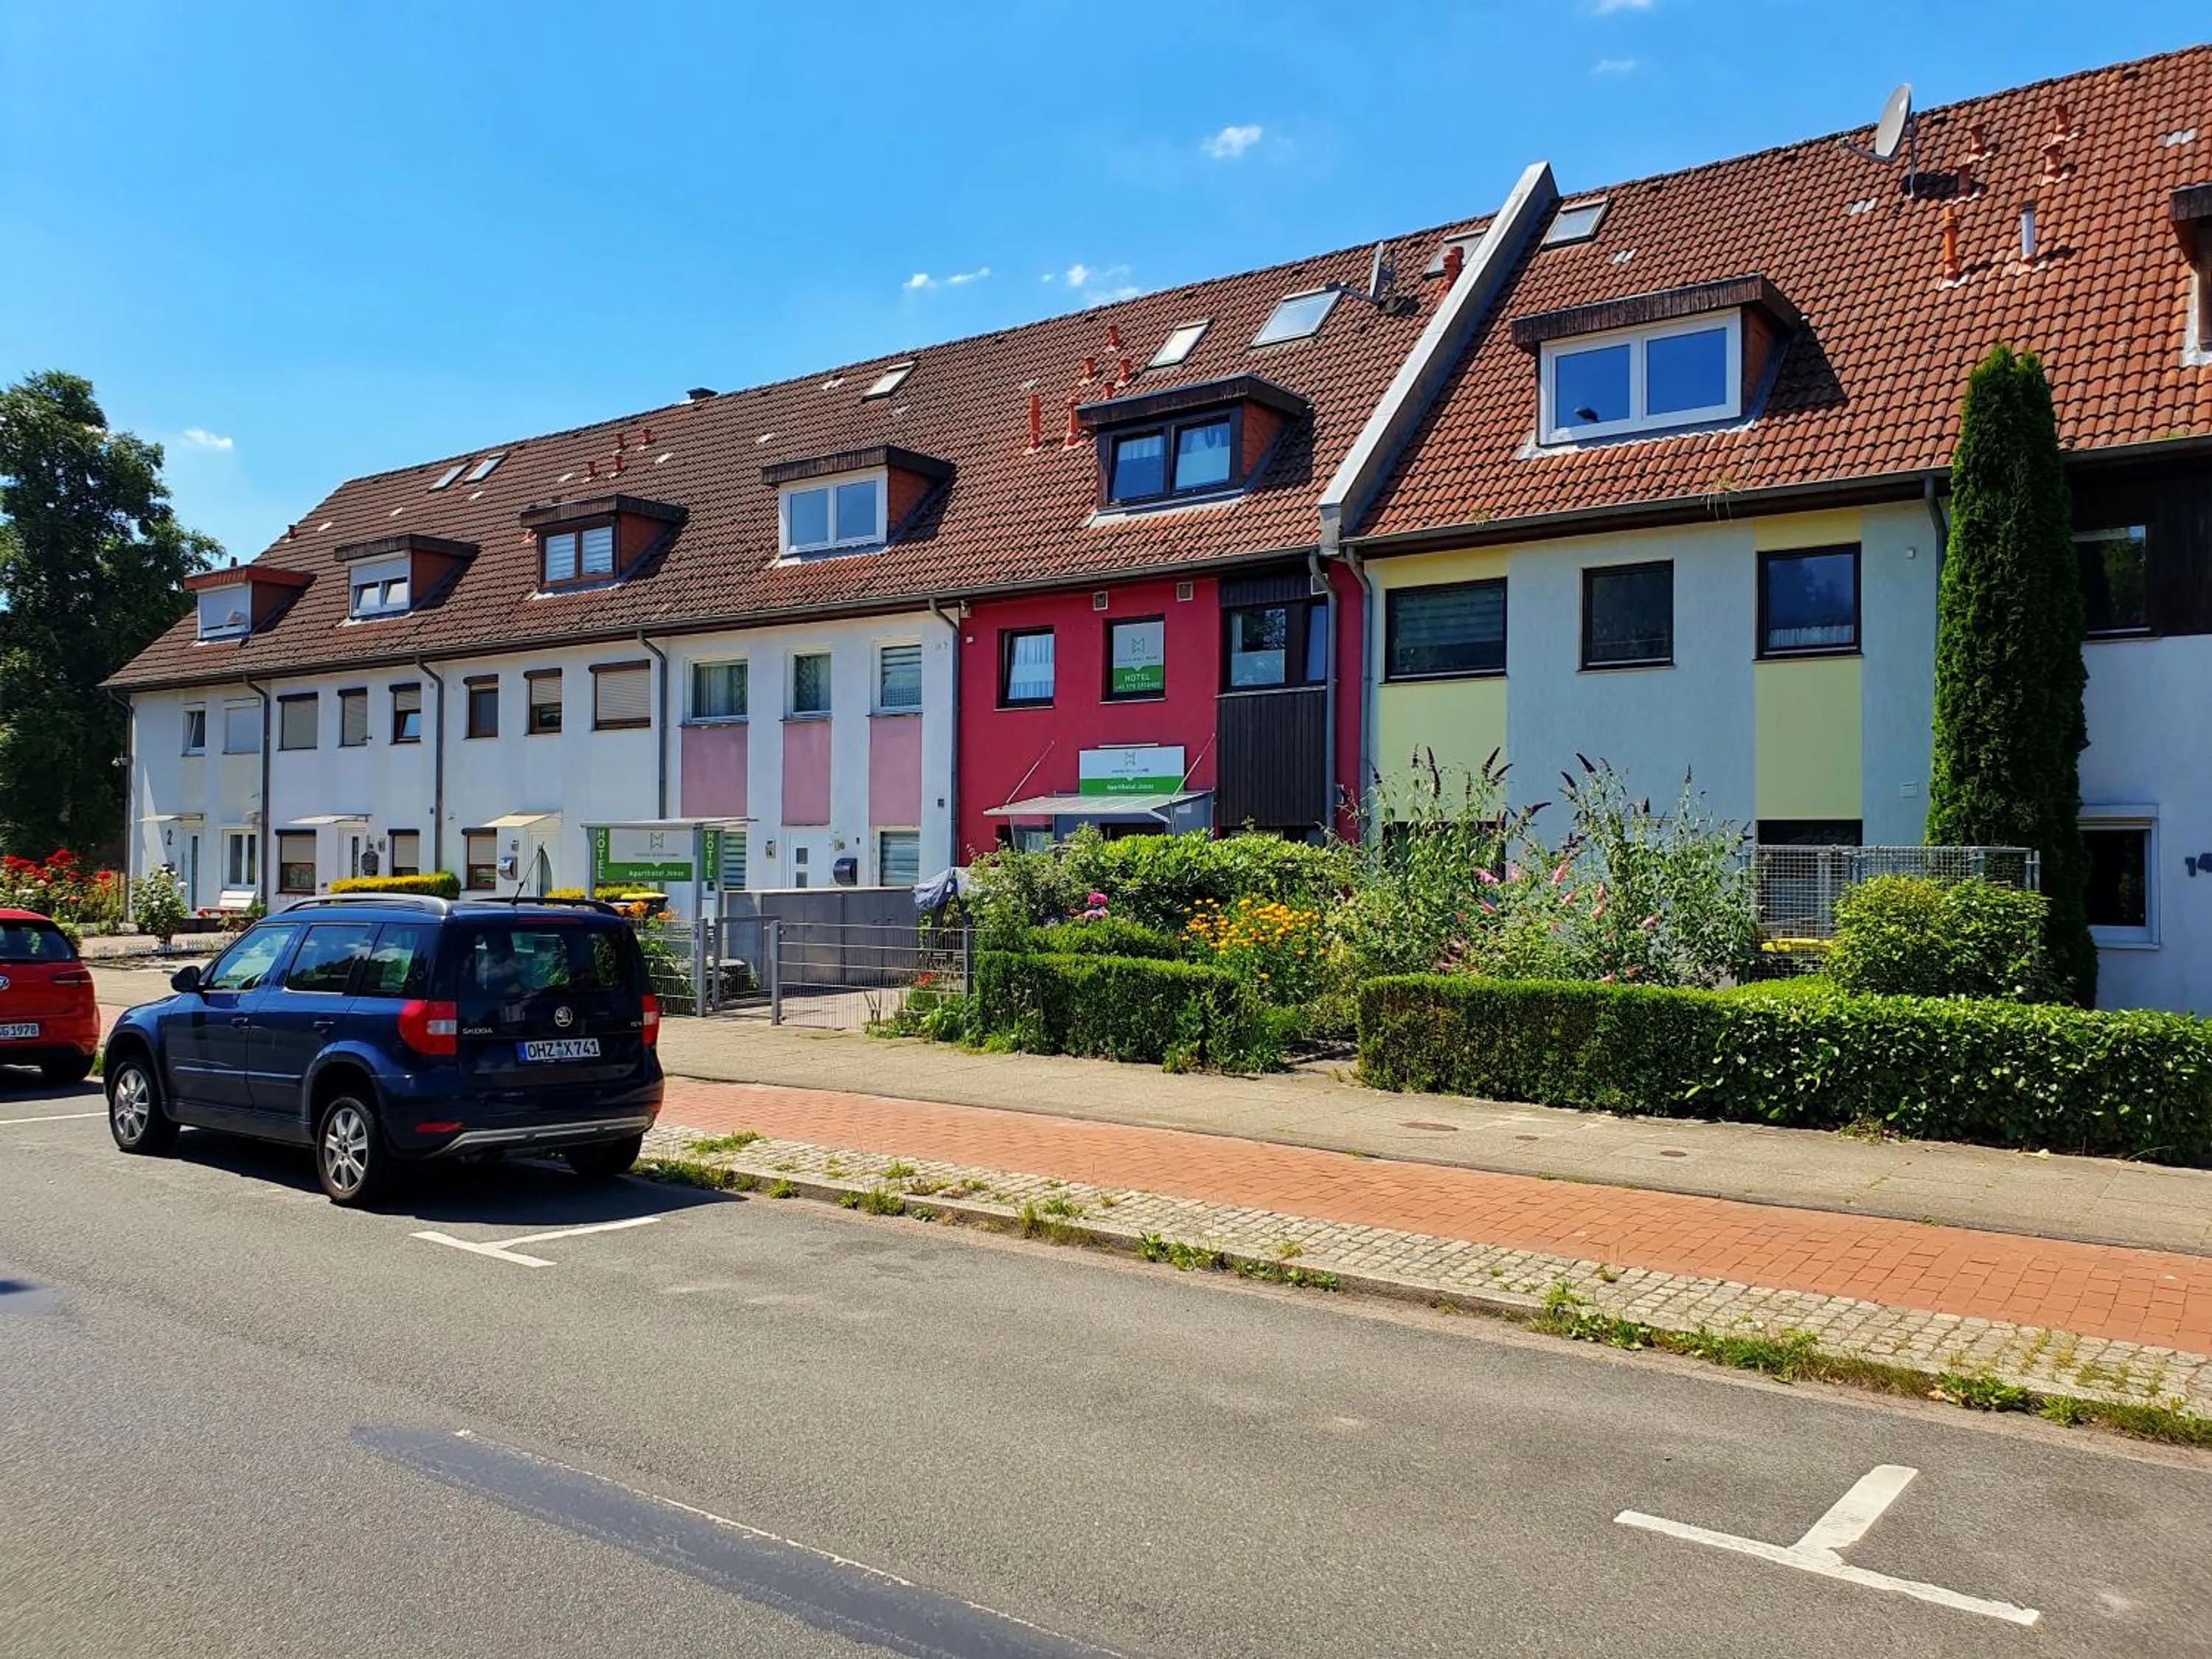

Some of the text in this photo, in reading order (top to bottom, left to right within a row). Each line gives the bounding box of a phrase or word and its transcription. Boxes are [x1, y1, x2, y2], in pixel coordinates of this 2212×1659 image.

[1124, 673, 1150, 683] HOTEL
[597, 828, 605, 879] HOTEL
[706, 832, 714, 878] HOTEL
[628, 870, 664, 878] Aparthotel
[527, 1042, 555, 1058] OHZ
